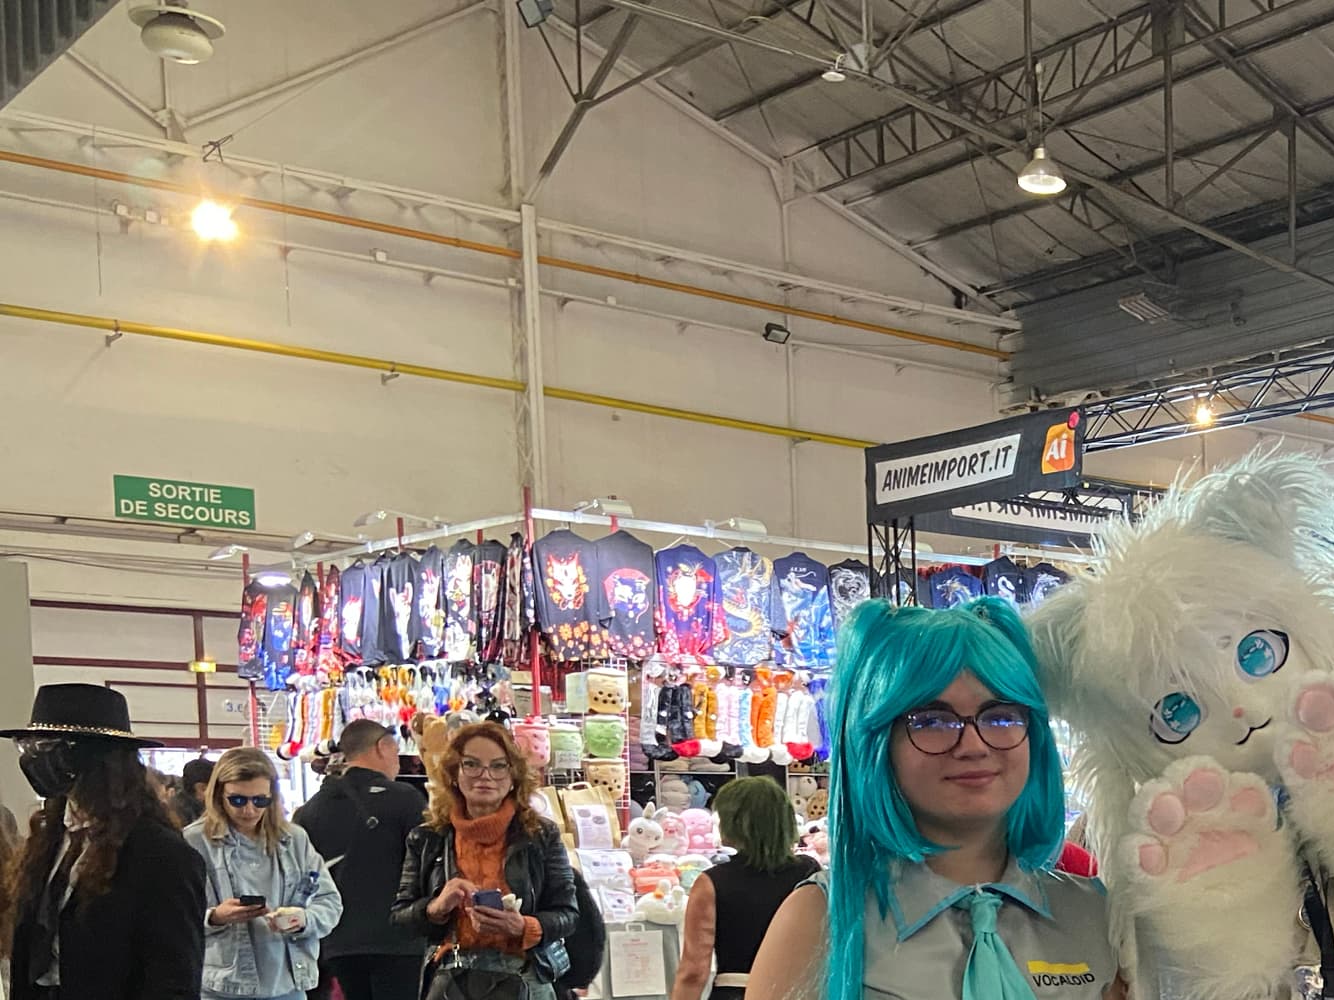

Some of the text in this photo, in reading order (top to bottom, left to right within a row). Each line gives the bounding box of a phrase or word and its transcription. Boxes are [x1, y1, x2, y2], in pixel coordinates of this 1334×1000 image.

[882, 444, 1013, 492] ANIMEIMPORT.IT
[148, 482, 222, 503] SORTIE
[120, 499, 251, 526] DE SECOURS
[1032, 973, 1096, 988] VOCALOID
